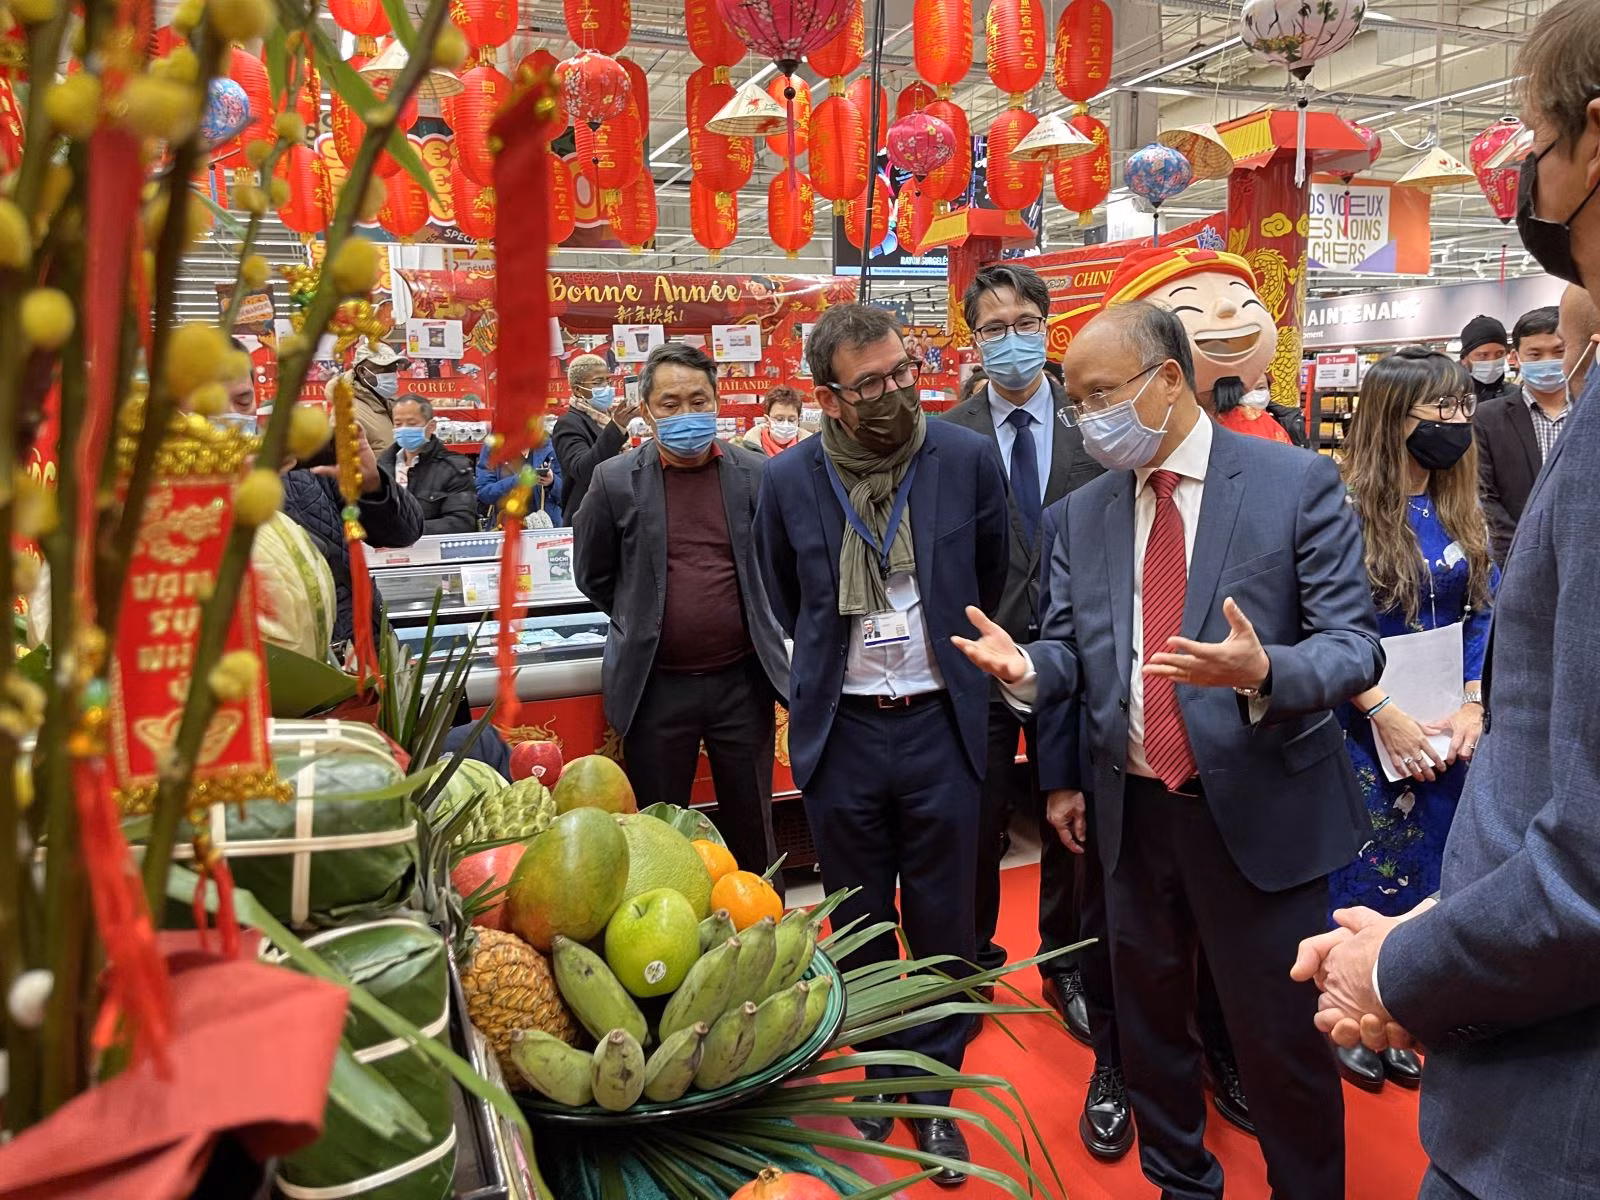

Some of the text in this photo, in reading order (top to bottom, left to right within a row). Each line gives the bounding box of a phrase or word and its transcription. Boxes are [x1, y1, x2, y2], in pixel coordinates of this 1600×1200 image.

[1309, 193, 1325, 215] OS
[1308, 218, 1332, 239] ES
[1312, 242, 1366, 264] CHERS
[549, 274, 742, 302] Bonne Année
